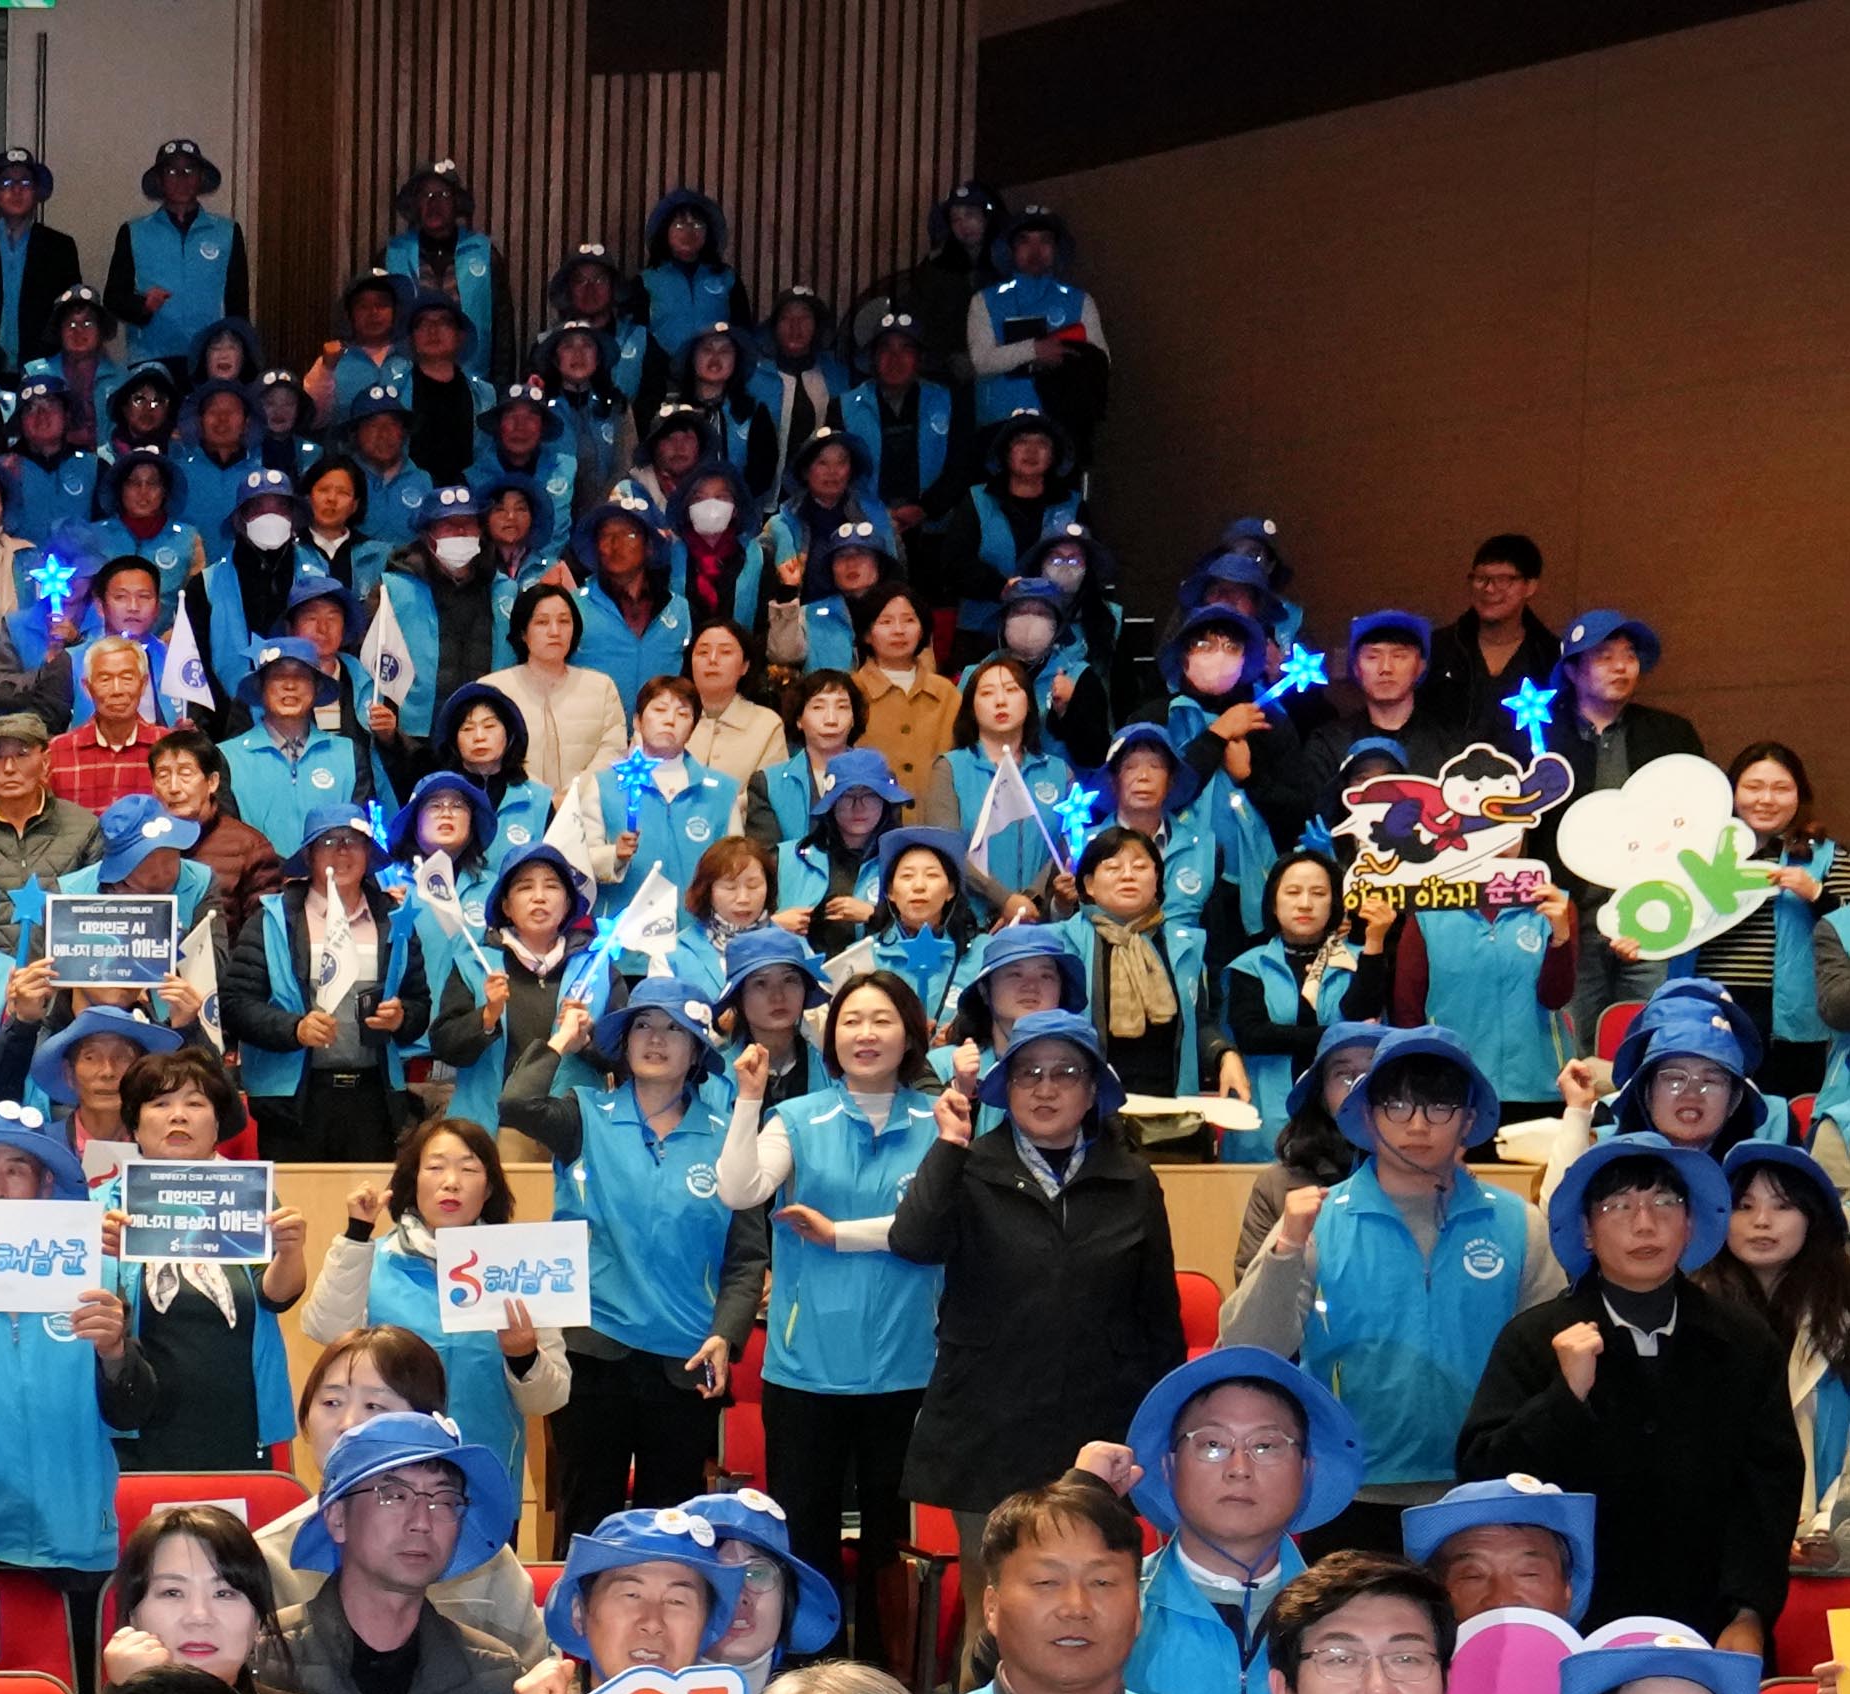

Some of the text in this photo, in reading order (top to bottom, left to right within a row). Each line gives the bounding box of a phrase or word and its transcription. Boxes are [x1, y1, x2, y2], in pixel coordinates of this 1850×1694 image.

[1615, 825, 1775, 952] OK
[131, 938, 171, 958] 해남
[217, 1190, 236, 1206] AI
[218, 1211, 264, 1231] 해남
[483, 1258, 576, 1296] 해남군
